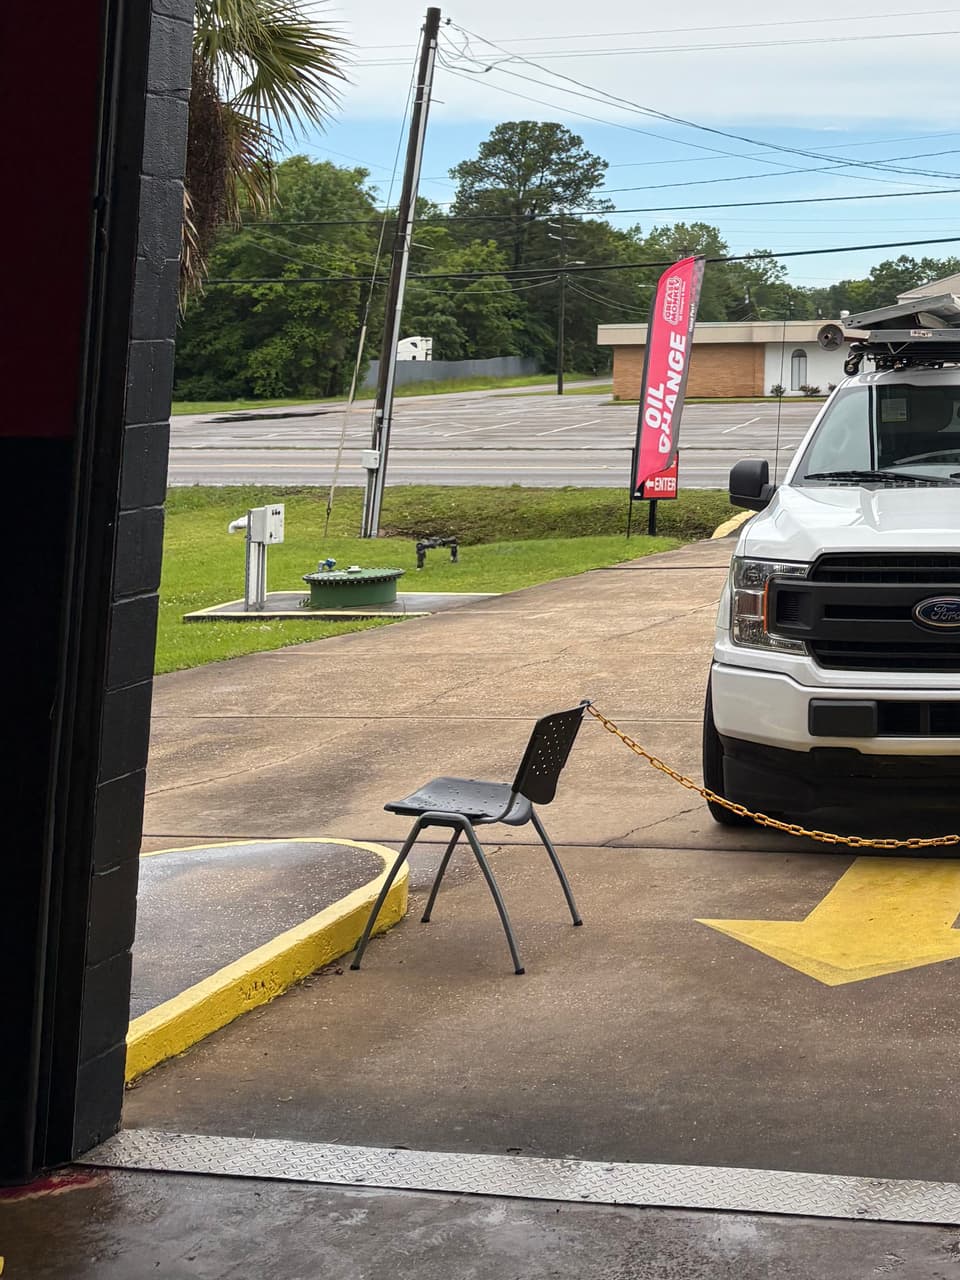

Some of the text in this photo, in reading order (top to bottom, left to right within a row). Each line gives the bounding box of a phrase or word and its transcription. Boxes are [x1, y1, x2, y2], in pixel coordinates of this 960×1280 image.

[645, 382, 665, 429] OIL
[658, 331, 686, 454] CHANGE
[654, 477, 676, 491] ENTER
